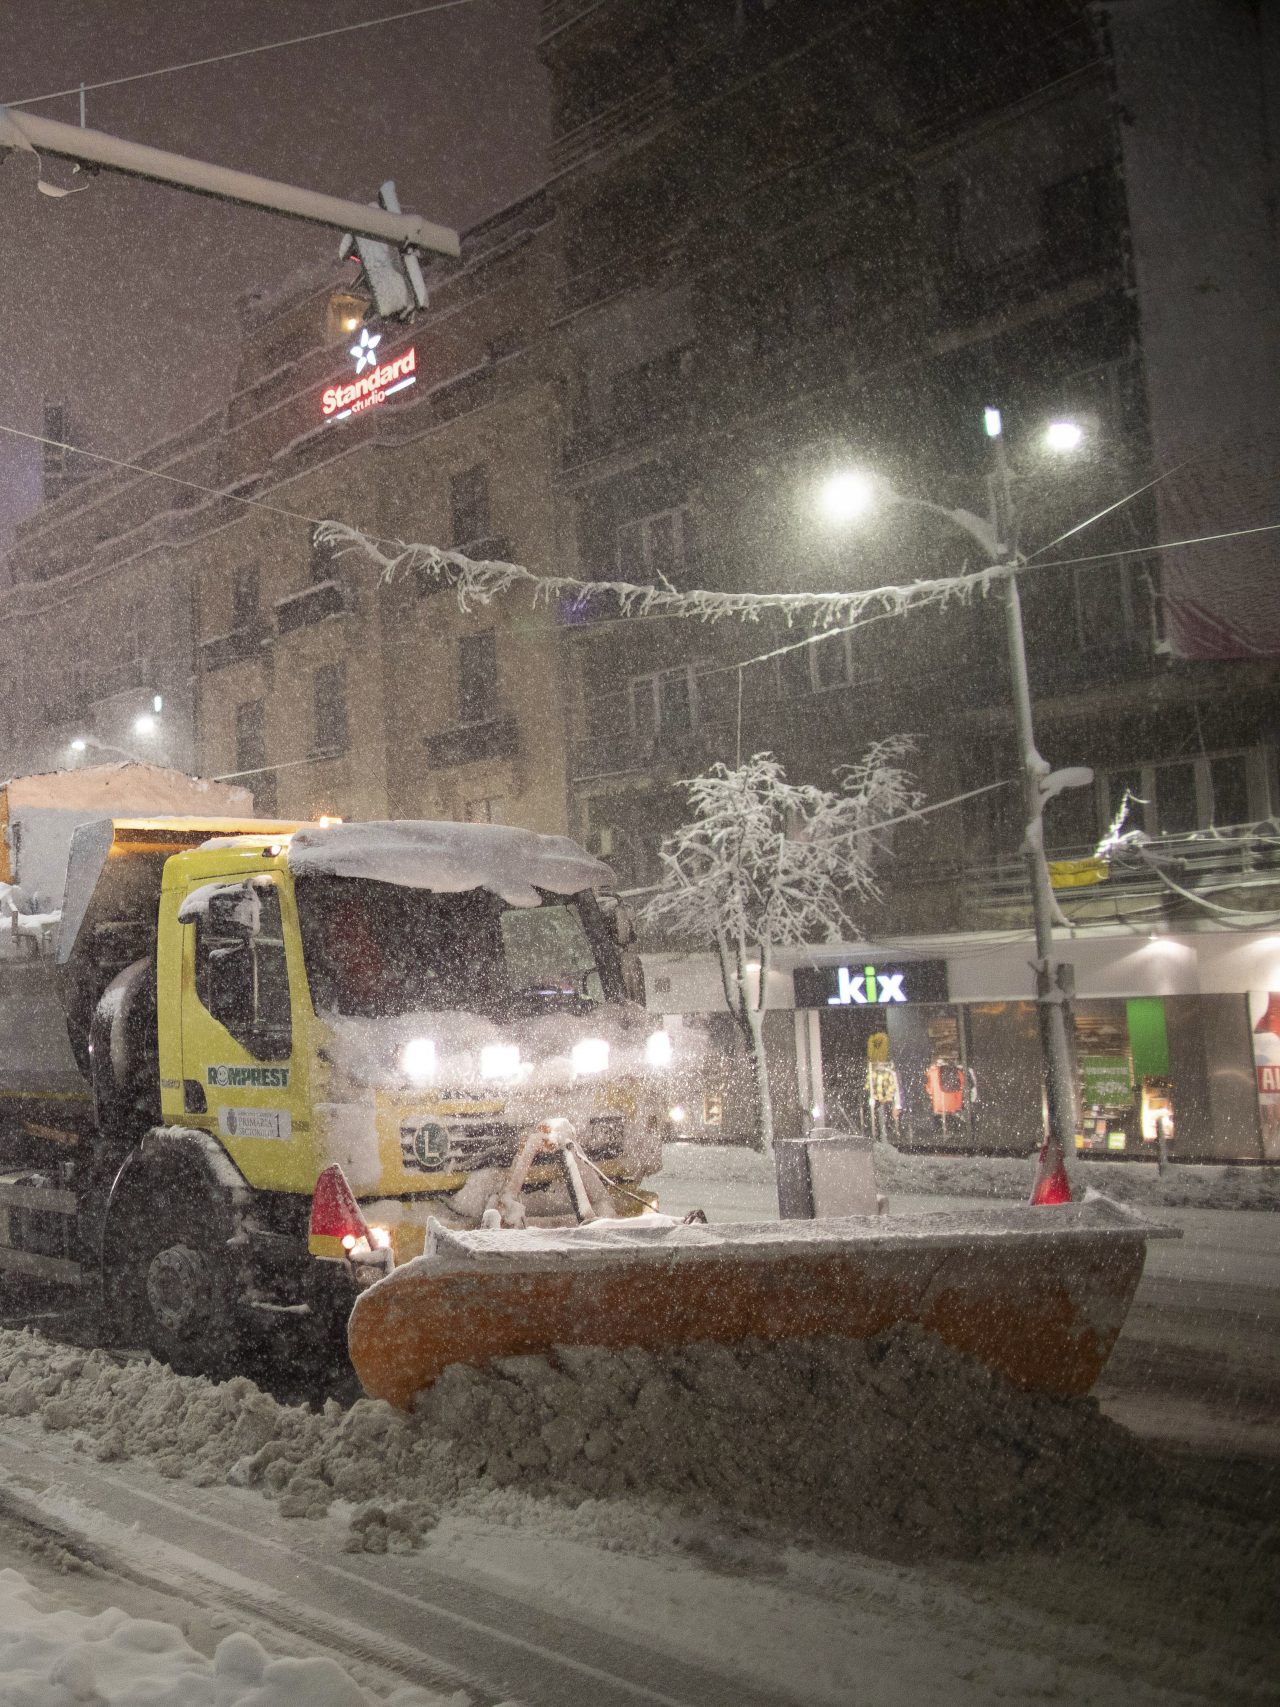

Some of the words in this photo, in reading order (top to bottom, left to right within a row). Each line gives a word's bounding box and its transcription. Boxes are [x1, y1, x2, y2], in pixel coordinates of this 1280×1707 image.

[323, 348, 415, 414] Standard
[208, 1066, 289, 1087] ROMPREST
[274, 1113, 281, 1138] 1
[423, 1130, 440, 1159] L
